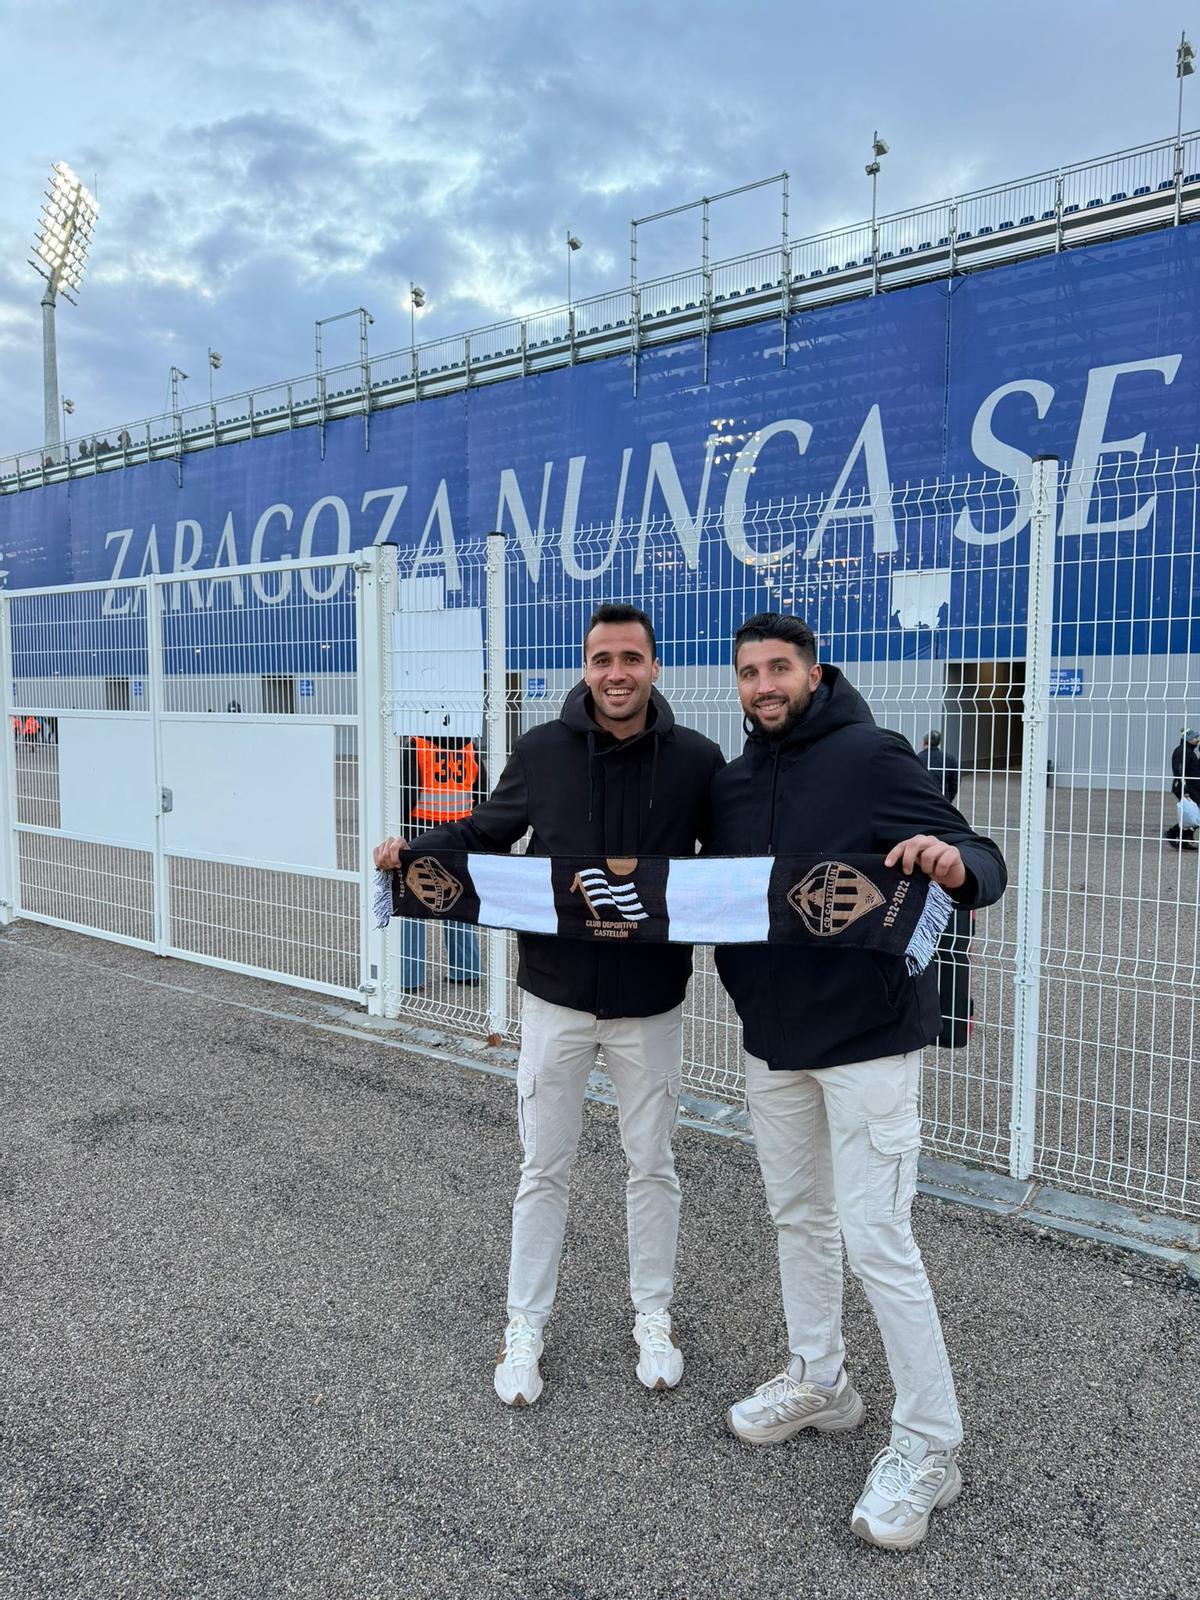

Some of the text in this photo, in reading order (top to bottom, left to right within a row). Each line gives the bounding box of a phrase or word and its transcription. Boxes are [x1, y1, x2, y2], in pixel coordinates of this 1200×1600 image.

[102, 354, 1182, 615] ZARAGOZA NUNCA SE
[434, 751, 467, 784] 33
[883, 880, 910, 928] 1922-2022
[585, 920, 638, 929] CLUB DEPORTIVO
[594, 929, 629, 938] CASTELLÓN
